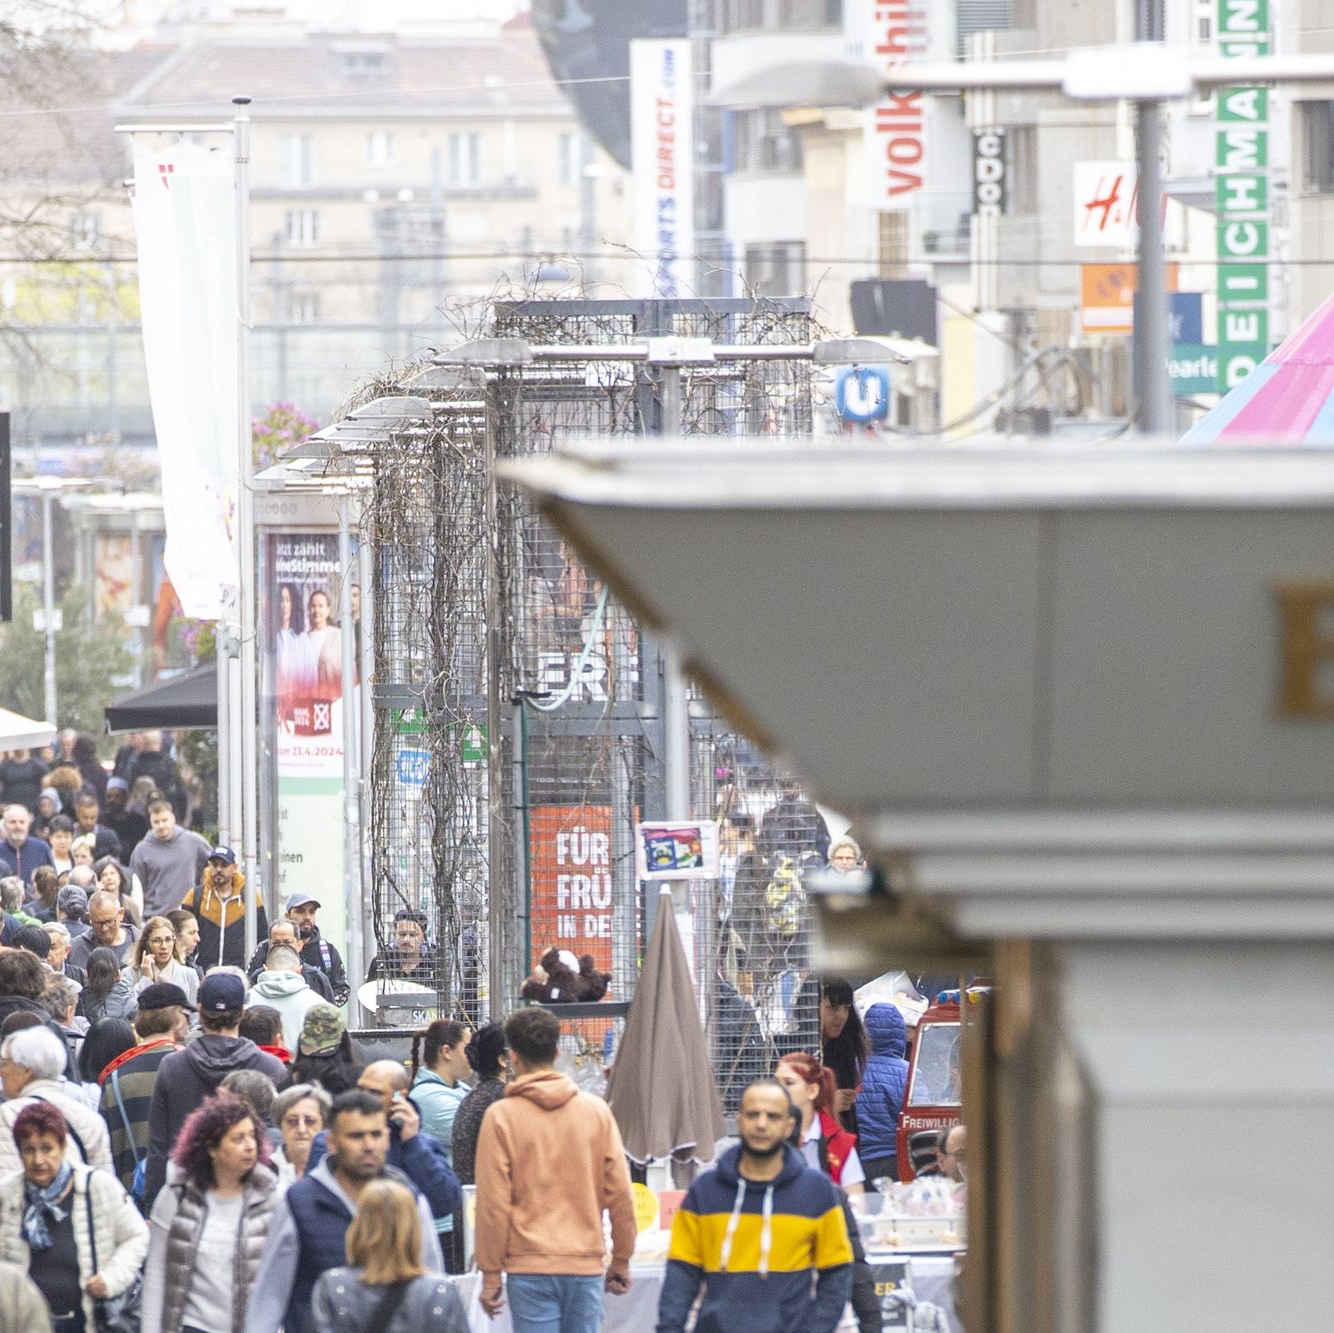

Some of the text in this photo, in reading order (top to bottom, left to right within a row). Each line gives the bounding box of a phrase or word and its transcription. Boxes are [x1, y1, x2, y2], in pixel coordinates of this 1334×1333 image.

[557, 826, 609, 864] FÜR
[557, 867, 613, 909] FRÜ
[558, 915, 613, 938] IN DE
